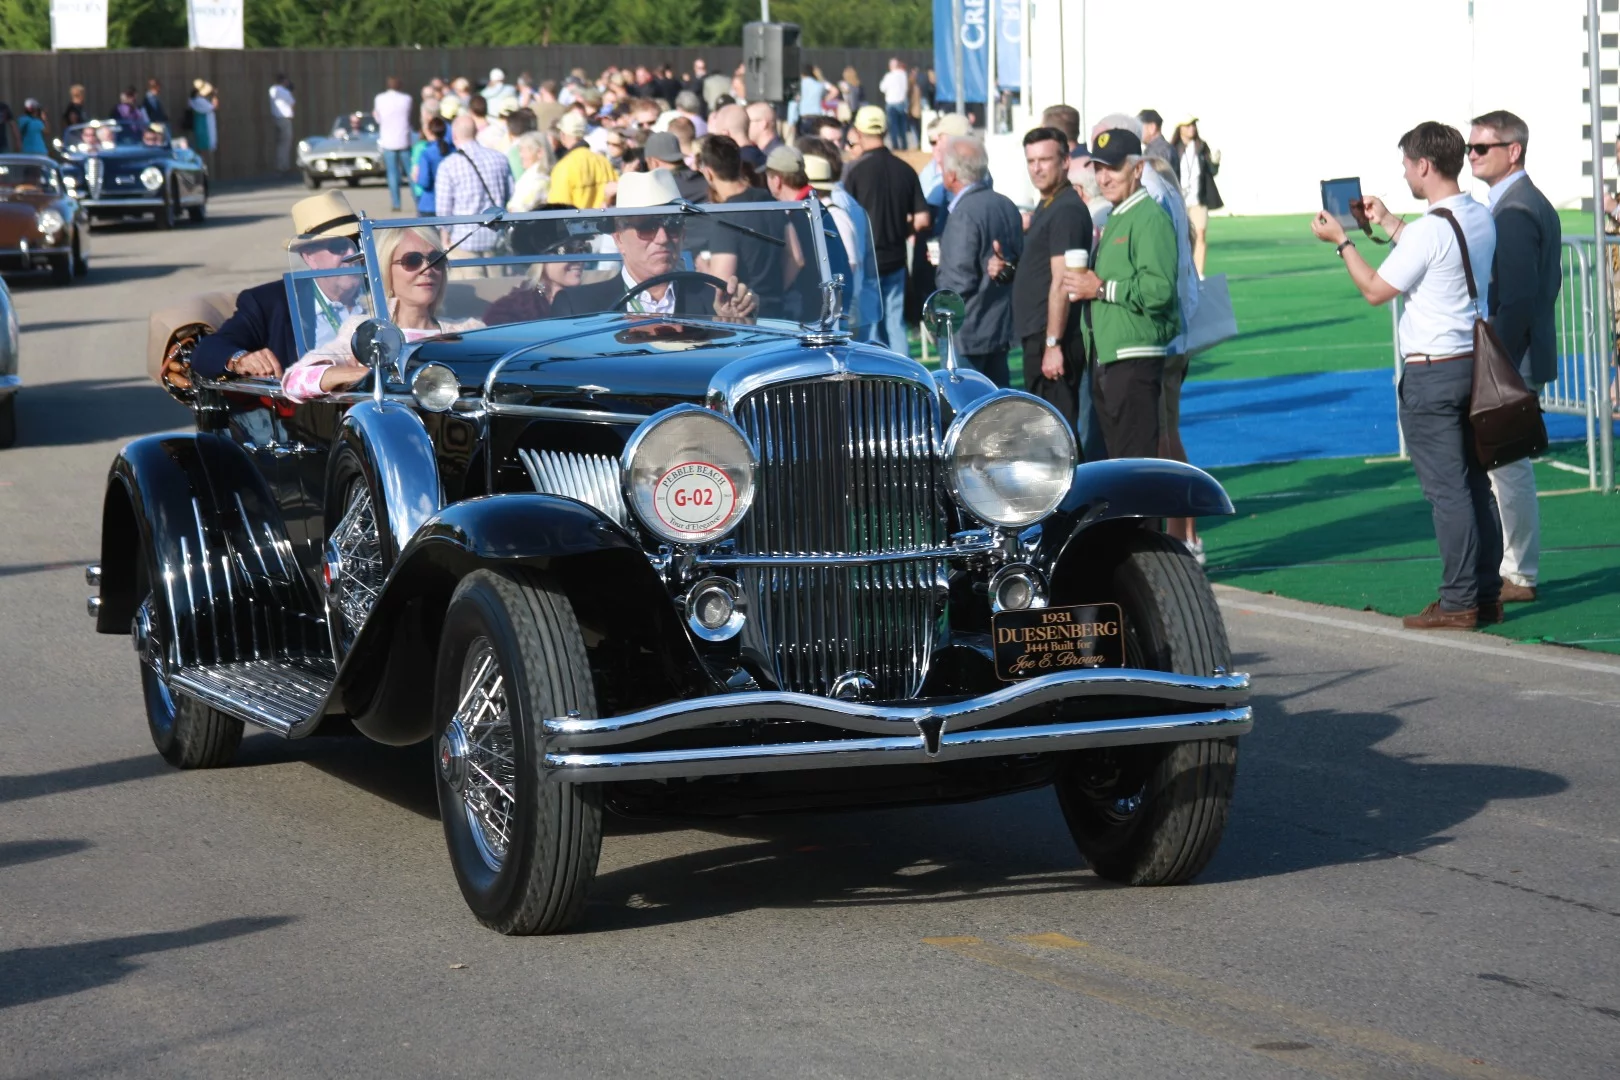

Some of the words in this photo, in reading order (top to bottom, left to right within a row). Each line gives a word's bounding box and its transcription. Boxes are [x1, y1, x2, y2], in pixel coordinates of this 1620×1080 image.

[662, 465, 695, 488] PEBBLE
[696, 465, 726, 486] BEACH
[674, 488, 713, 507] G-02
[669, 517, 684, 529] Tour
[1041, 612, 1072, 624] 1931
[998, 621, 1118, 644] DUESENBERG
[1025, 643, 1048, 654] J444
[1051, 640, 1074, 651] Built
[1076, 639, 1093, 649] for
[1009, 654, 1036, 673] Joe
[1038, 652, 1053, 668] E.
[1056, 651, 1105, 666] Brown
